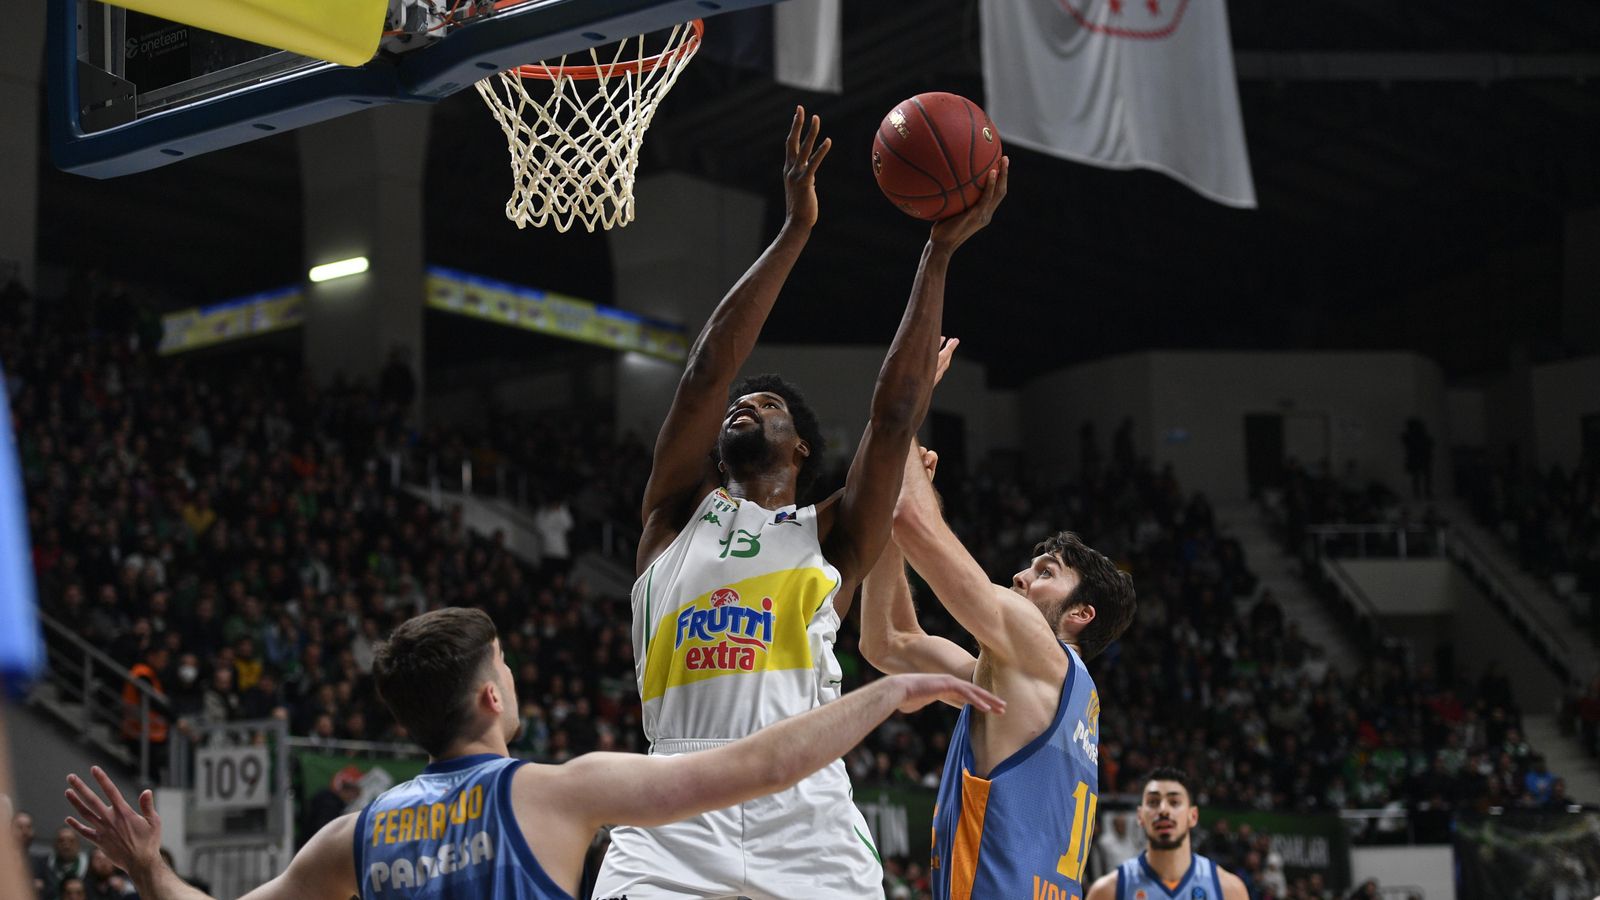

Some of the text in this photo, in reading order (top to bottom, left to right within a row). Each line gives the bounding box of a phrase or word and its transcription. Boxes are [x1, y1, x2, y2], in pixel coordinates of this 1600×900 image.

[140, 29, 188, 53] oneteam
[718, 529, 761, 559] 13
[685, 640, 756, 671] extra
[203, 755, 262, 801] 109
